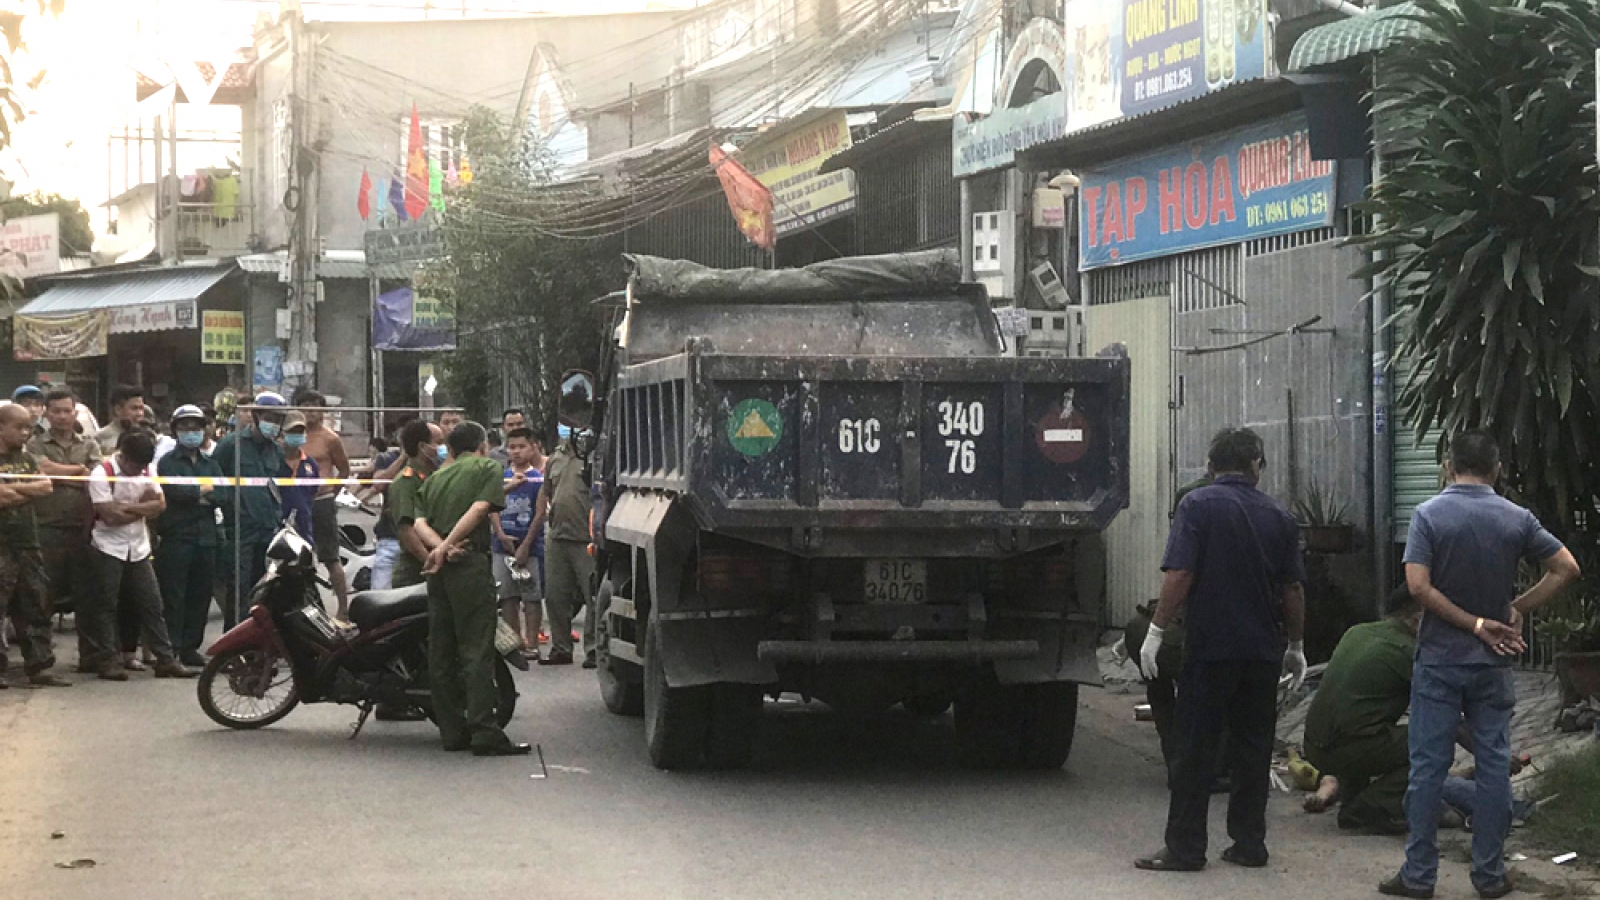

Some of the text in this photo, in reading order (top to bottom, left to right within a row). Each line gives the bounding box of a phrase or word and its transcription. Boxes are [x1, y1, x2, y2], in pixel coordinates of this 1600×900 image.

[1126, 0, 1198, 48] QUANG LINH
[1083, 177, 1148, 259] TẠP
[1238, 135, 1292, 200] QUANG
[1265, 200, 1288, 223] 0981
[1290, 194, 1309, 218] 063
[839, 418, 881, 453] 61C
[938, 401, 985, 436] 340
[945, 439, 976, 474] 76
[879, 561, 912, 581] 61C
